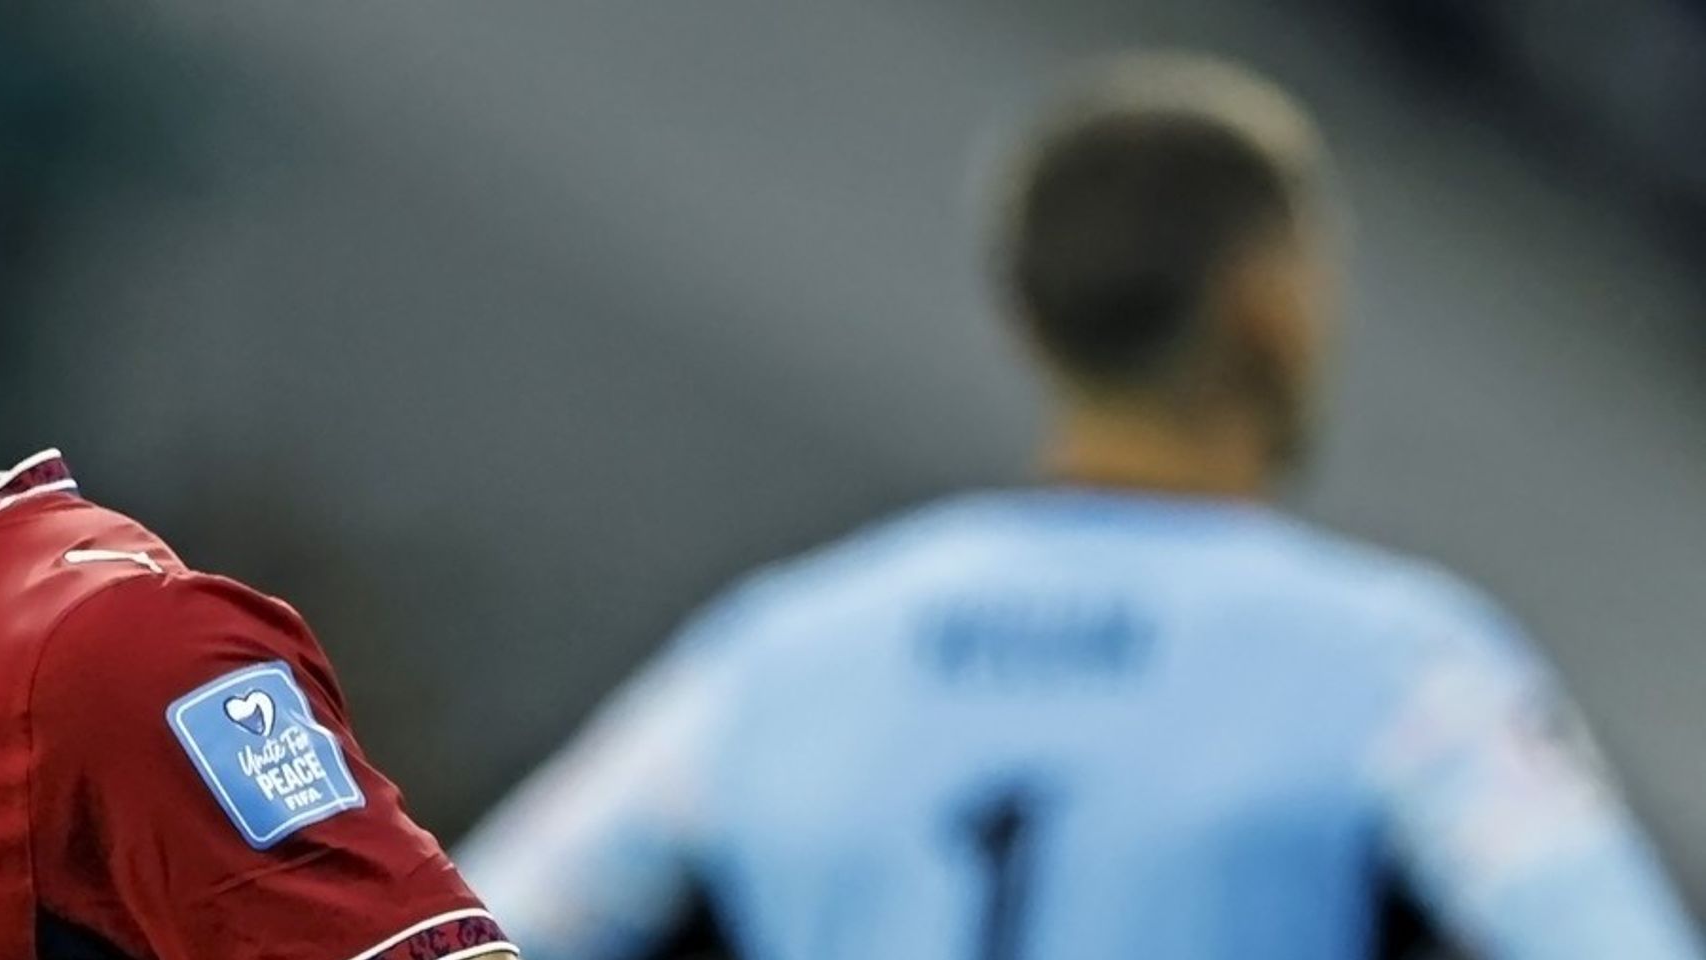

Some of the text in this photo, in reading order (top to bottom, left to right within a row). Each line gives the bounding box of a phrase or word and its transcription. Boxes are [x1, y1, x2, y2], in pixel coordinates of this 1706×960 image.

[237, 737, 286, 777] Unite
[255, 751, 327, 801] PEACE
[283, 787, 323, 811] FIFA
